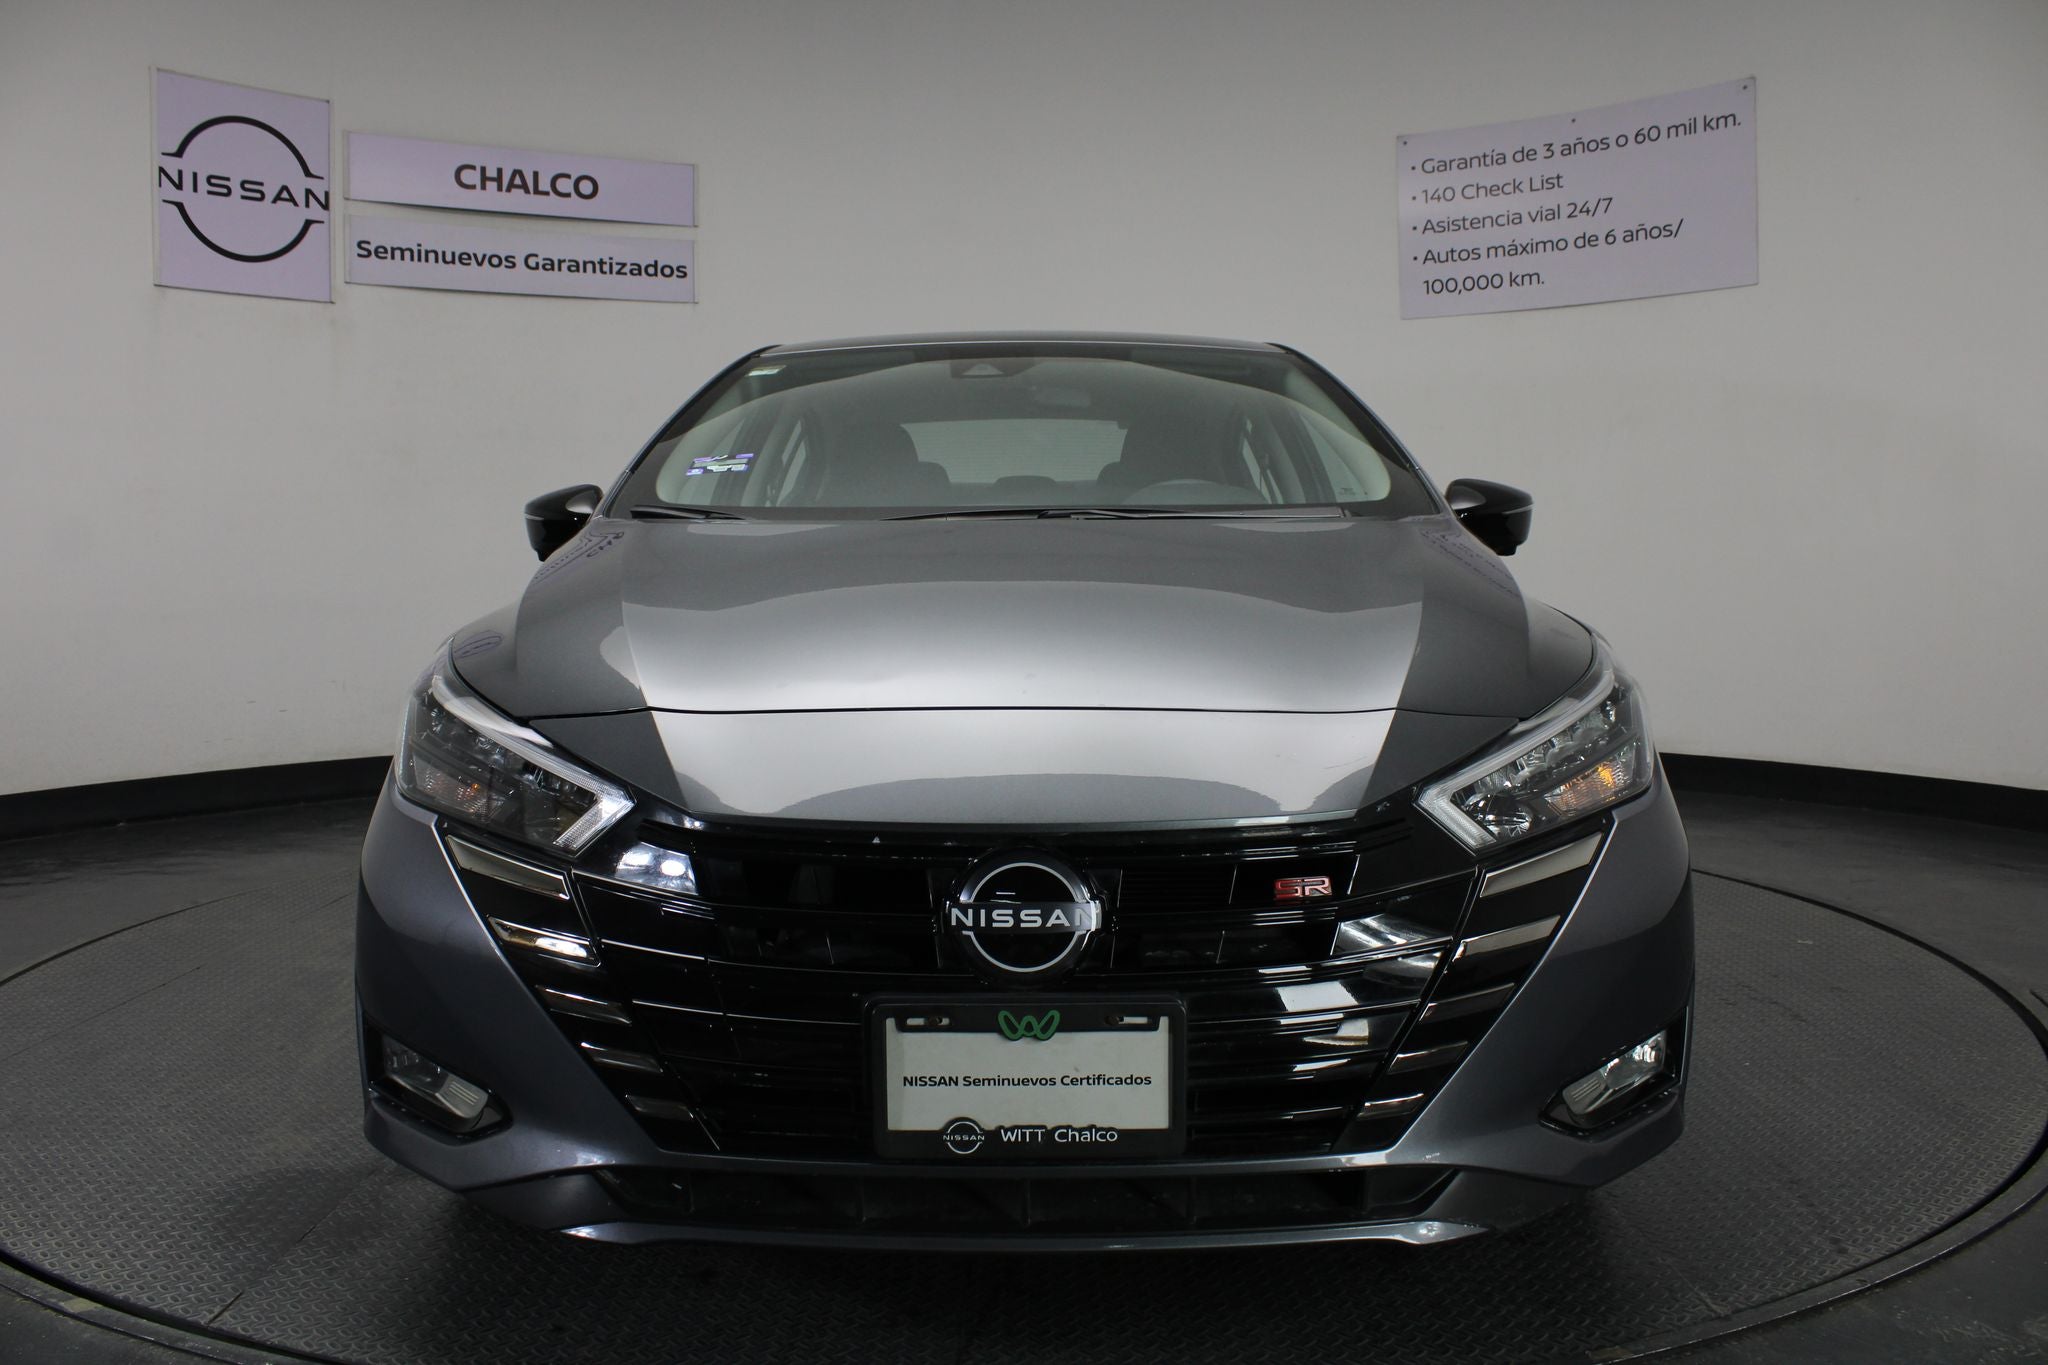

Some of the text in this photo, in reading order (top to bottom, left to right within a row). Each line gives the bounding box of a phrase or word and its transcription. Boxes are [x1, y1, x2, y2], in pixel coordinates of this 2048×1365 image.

[1421, 111, 1742, 174] Garantía de 3 años o 60 mil km.
[158, 165, 329, 211] NISSAN
[454, 163, 600, 201] CHALCO
[1421, 172, 1564, 205] 140 Check List
[1422, 197, 1614, 235] Asistencia vial 24/7
[1422, 218, 1684, 265] Autos máximo de 6 años/
[356, 240, 689, 280] Seminuevos Garantizados
[1423, 270, 1545, 296] 100,000 km.
[1275, 876, 1332, 898] SR
[951, 908, 1096, 928] NISSAN
[903, 1073, 1152, 1087] NISSAN Seminuevos Certificados
[1000, 1126, 1118, 1143] WITT Chalco
